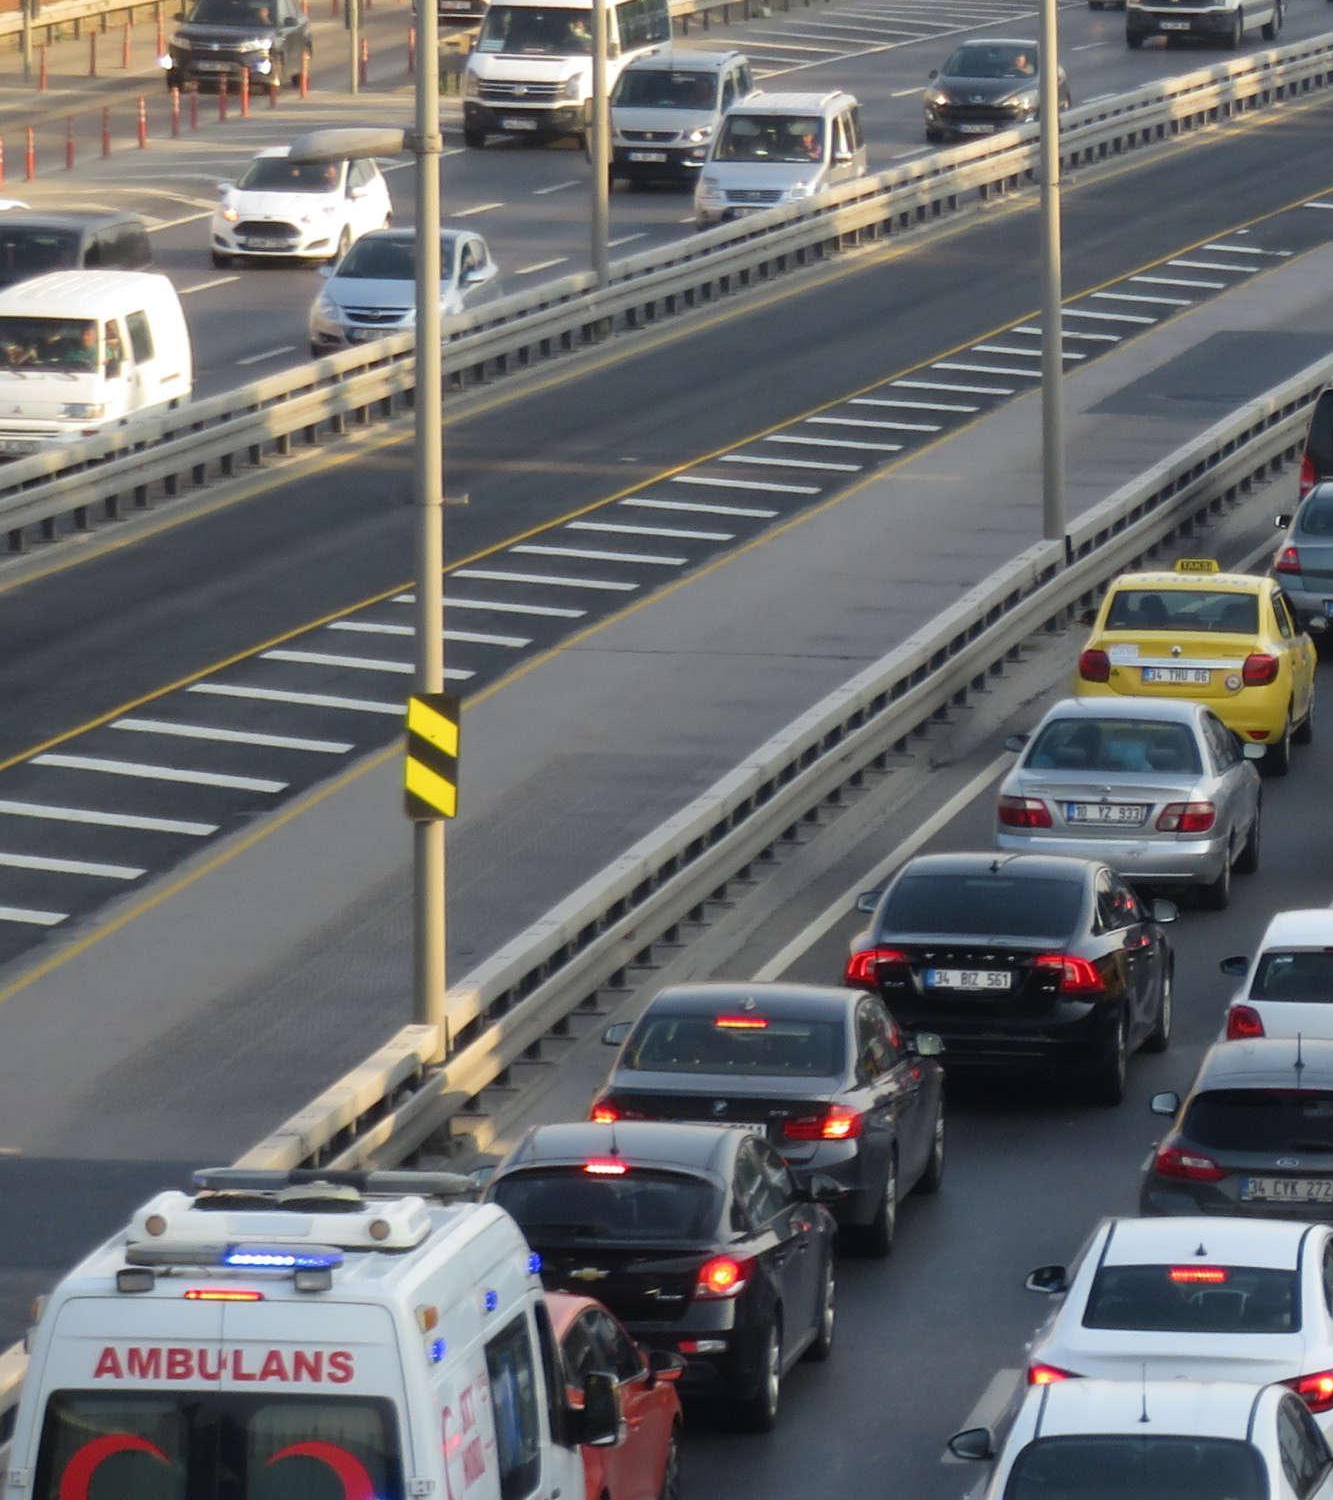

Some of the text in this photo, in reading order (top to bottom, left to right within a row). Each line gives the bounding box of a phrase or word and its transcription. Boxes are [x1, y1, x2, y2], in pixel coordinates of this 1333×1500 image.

[1151, 669, 1163, 680] 34
[1098, 804, 1112, 818] YZ
[937, 969, 1009, 988] 34 BIZ 561
[1249, 1177, 1333, 1197] 34 CYK 272
[94, 1345, 354, 1384] AMBULANS
